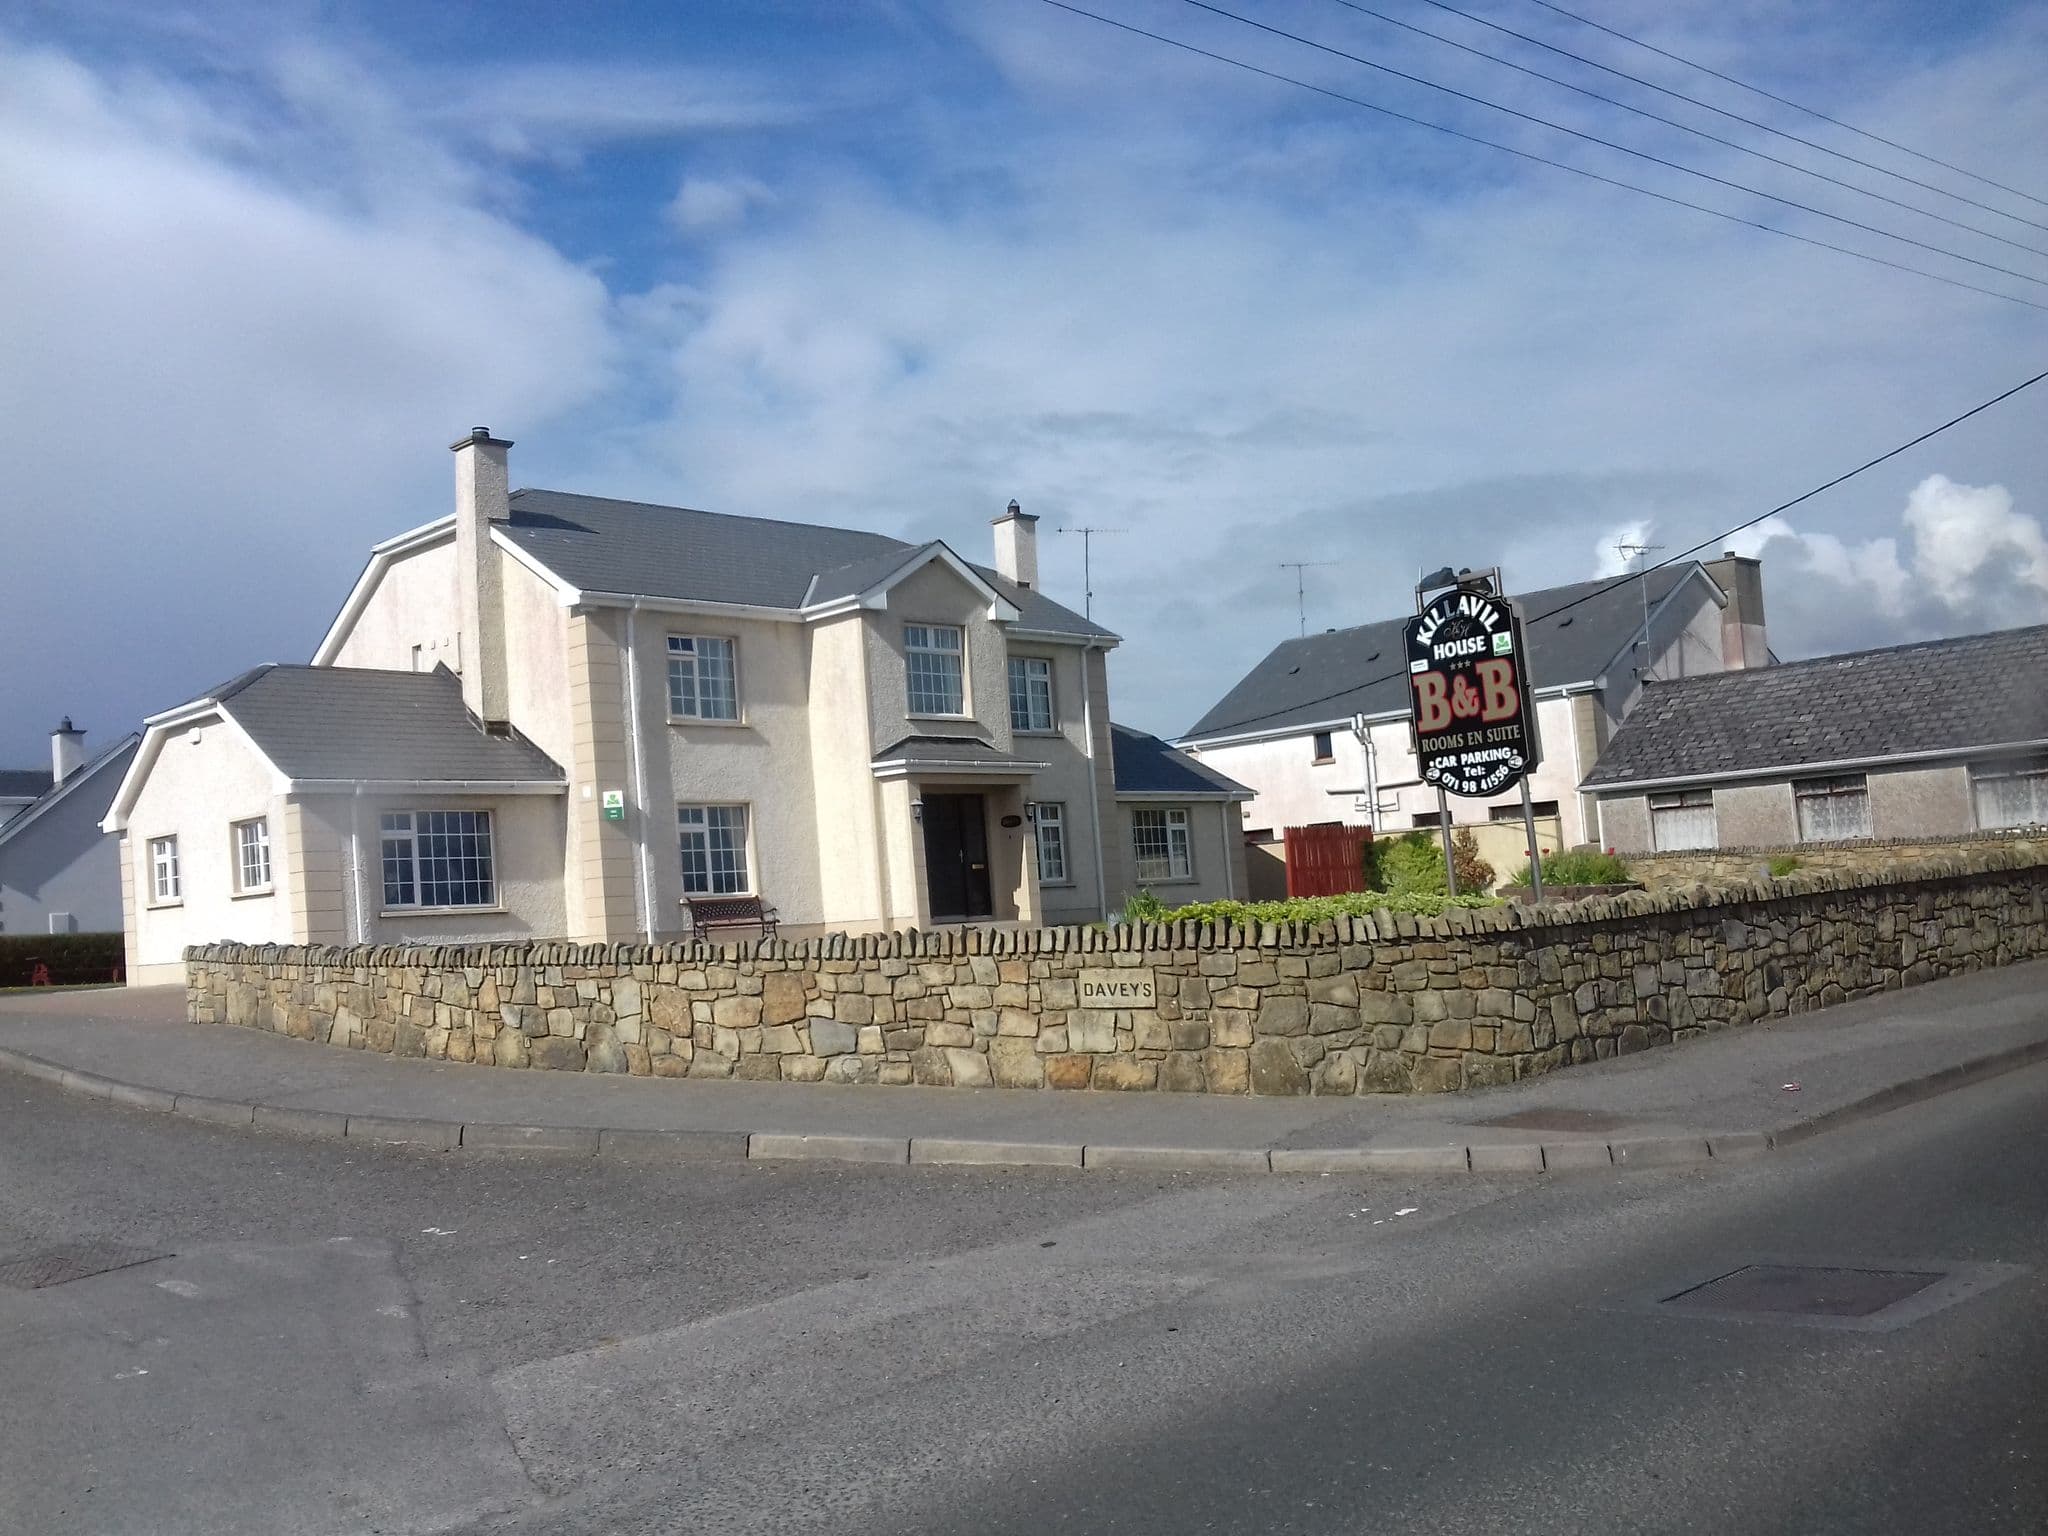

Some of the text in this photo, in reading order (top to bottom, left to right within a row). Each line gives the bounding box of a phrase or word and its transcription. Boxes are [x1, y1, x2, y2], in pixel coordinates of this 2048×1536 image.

[1433, 635, 1487, 660] HOUSE
[1412, 658, 1519, 733] B&B
[1421, 725, 1521, 752] ROOMS EN SUITE
[1435, 747, 1511, 769] CAR PARKING
[1441, 765, 1509, 793] 071 98 41556
[1463, 765, 1486, 778] Tel:
[1084, 982, 1151, 997] DAVEY'S
